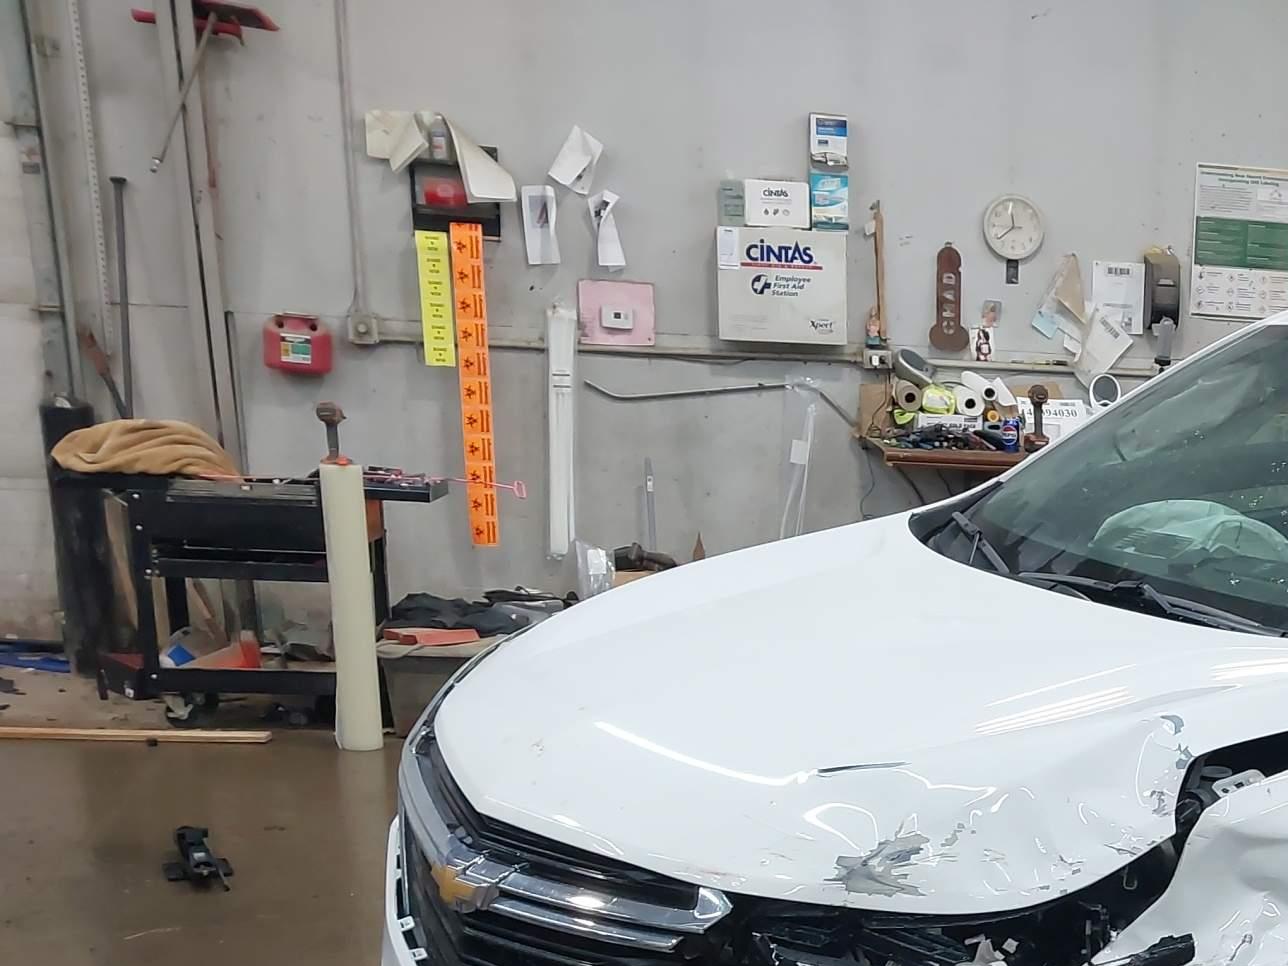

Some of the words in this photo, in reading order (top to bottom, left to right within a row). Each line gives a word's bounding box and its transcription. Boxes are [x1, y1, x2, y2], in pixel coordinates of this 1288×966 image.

[745, 238, 814, 264] CINTAS
[775, 275, 811, 285] Employee
[791, 282, 805, 290] Aid
[771, 289, 799, 297] Station
